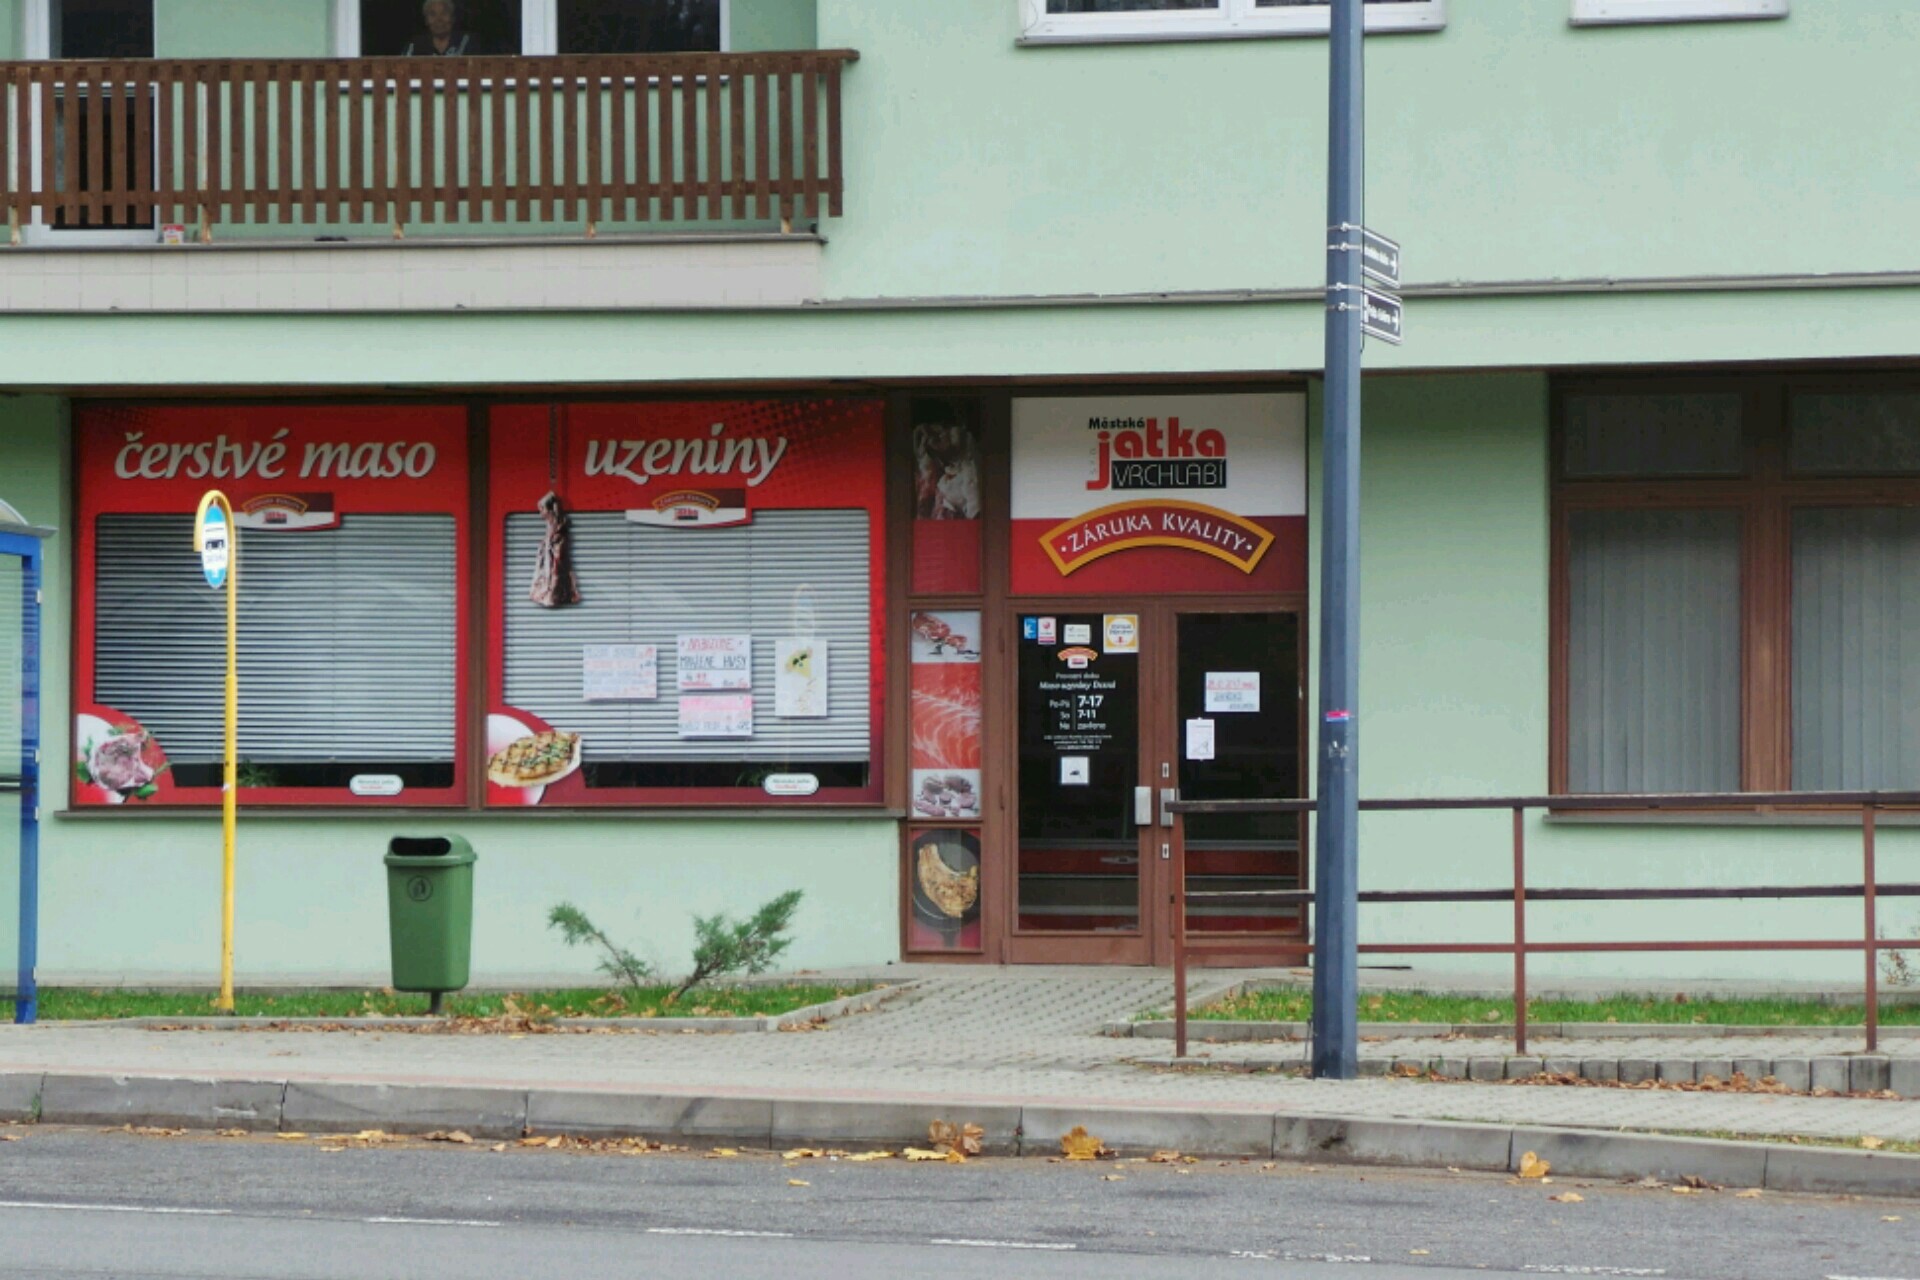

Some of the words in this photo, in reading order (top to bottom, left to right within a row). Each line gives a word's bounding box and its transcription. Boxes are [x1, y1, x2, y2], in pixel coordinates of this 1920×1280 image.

[1088, 416, 1145, 430] Městská
[114, 427, 290, 480] čerstvé
[299, 440, 436, 480] maso
[584, 423, 788, 487] uzeniny
[1085, 416, 1227, 491] jatka
[1113, 459, 1225, 487] VRCHLABÍ
[1067, 511, 1152, 553] ZÁRUKA
[1162, 512, 1248, 551] KVALITY
[1077, 695, 1104, 708] 7-17
[1077, 709, 1096, 719] 7-11
